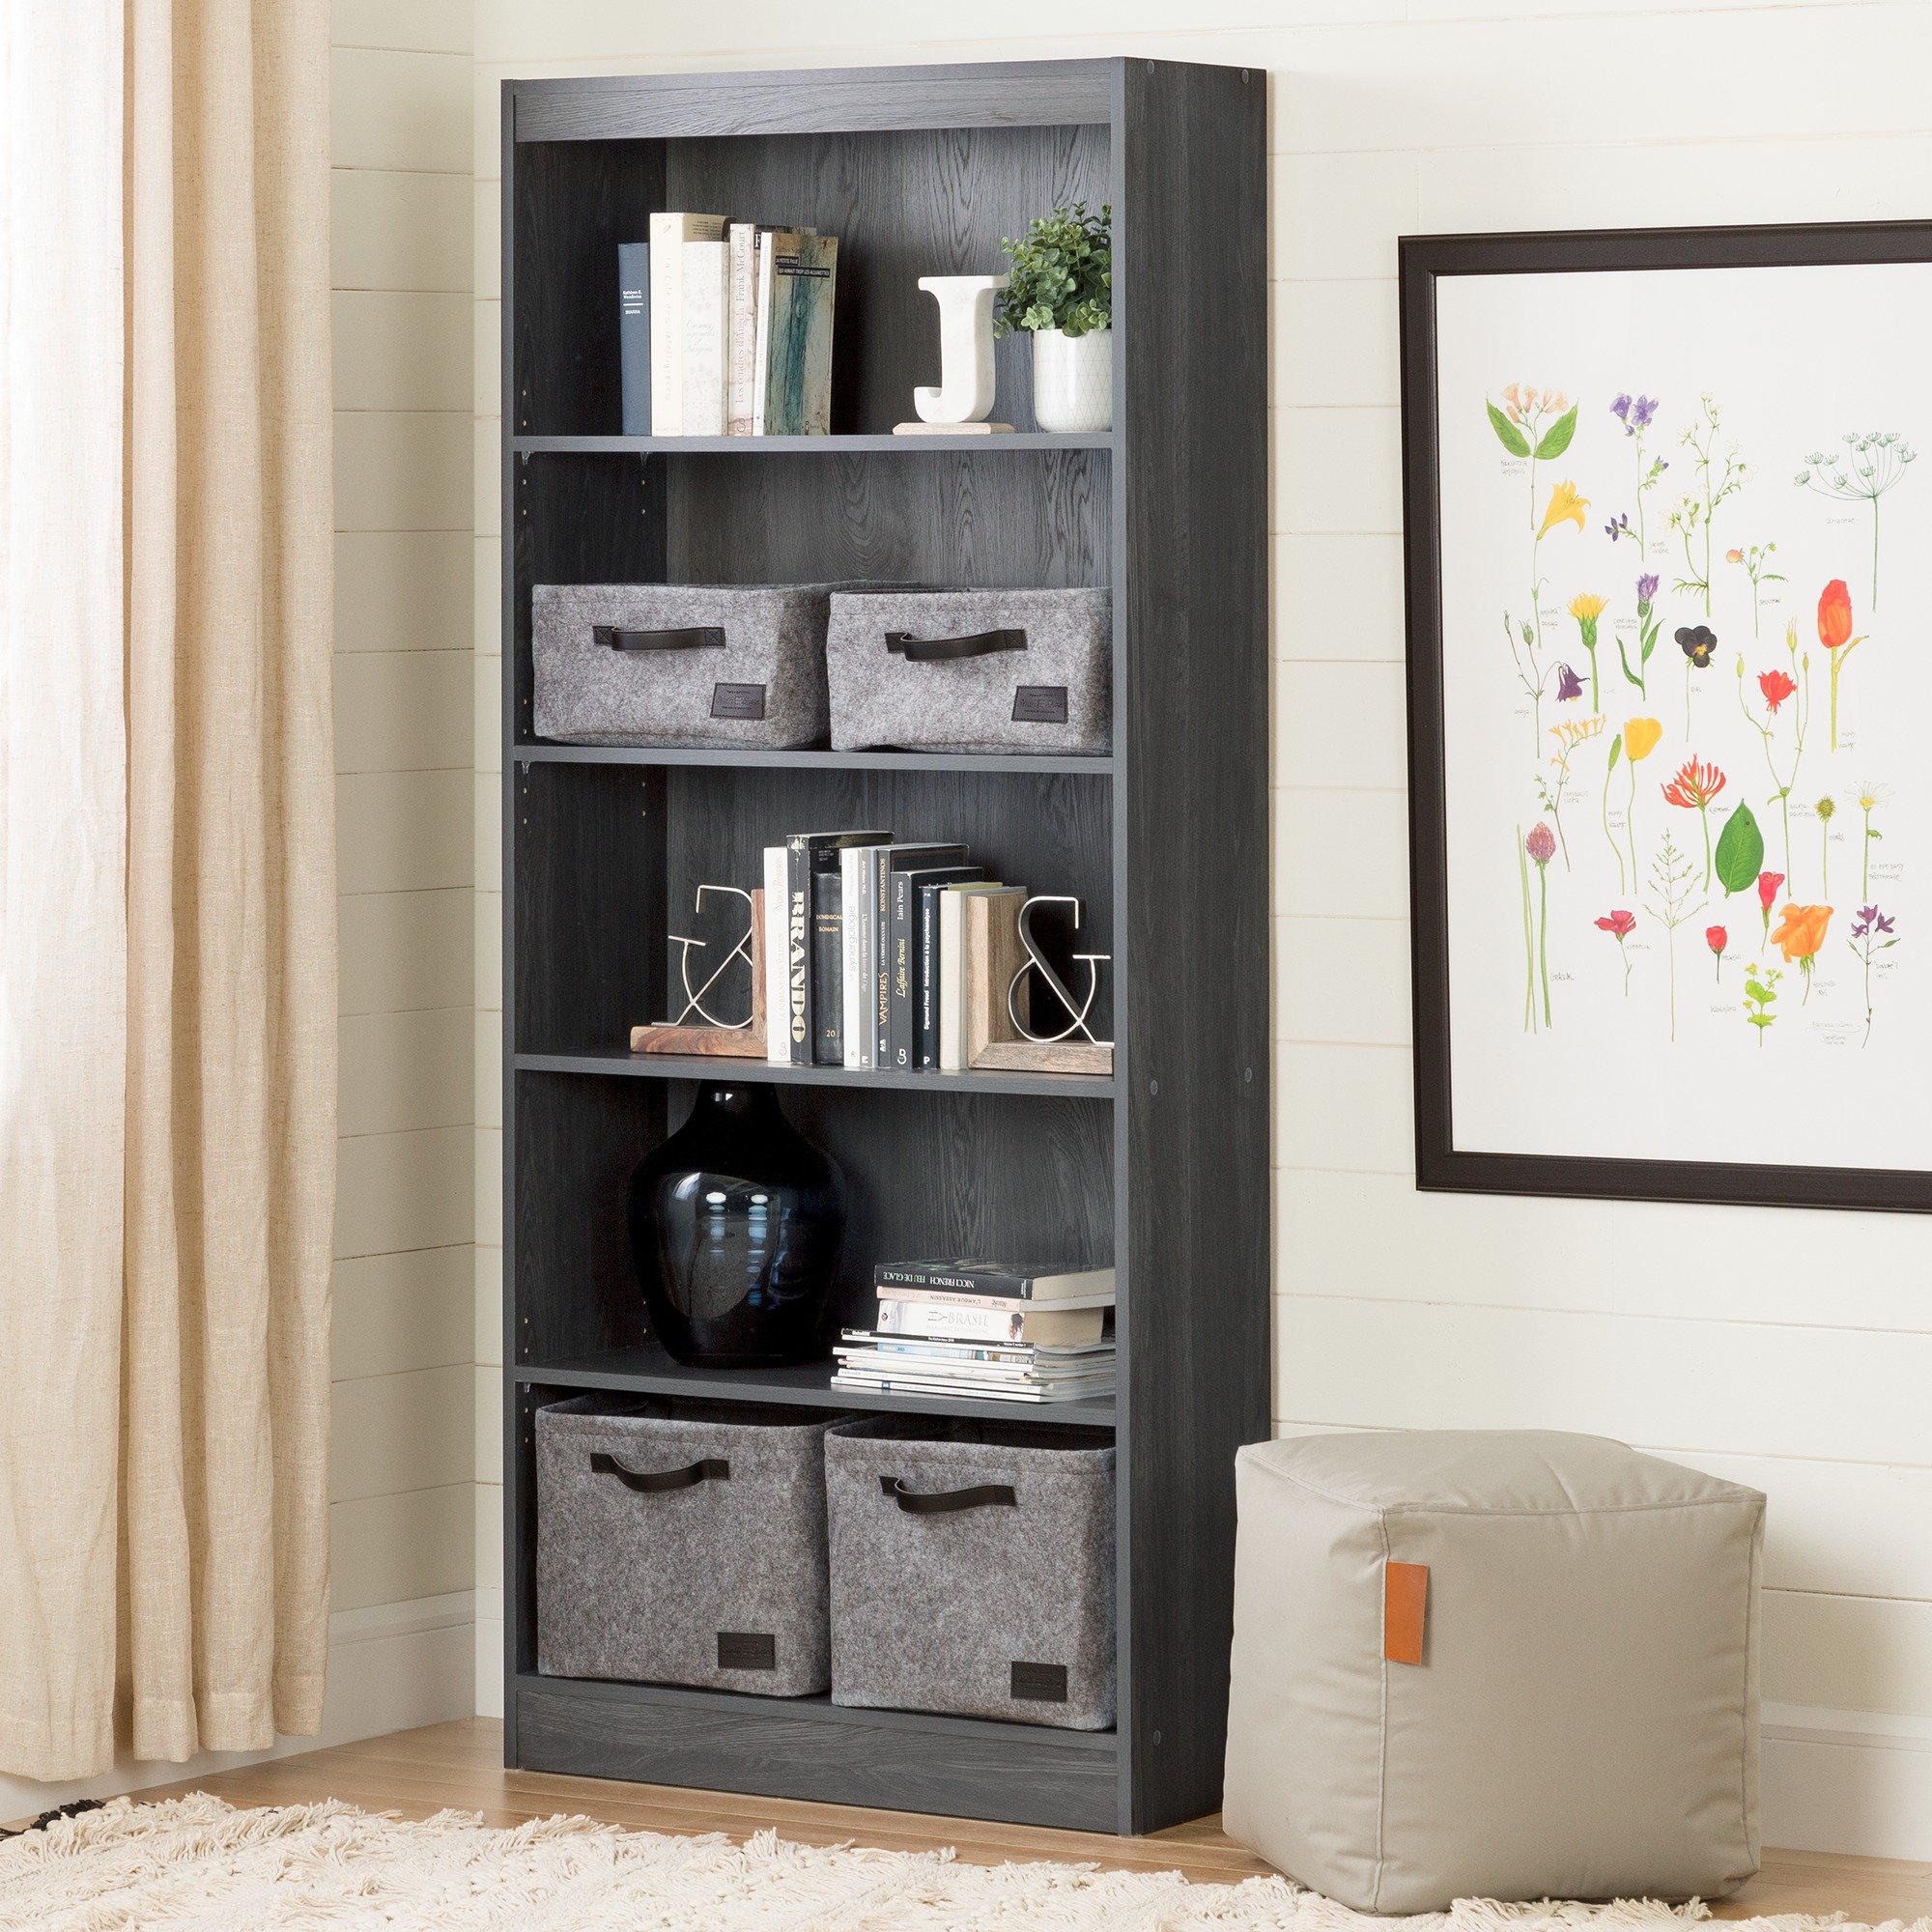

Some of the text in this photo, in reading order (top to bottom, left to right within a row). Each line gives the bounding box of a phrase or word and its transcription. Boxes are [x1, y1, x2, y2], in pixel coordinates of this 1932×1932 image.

[735, 232, 746, 273] McCourt
[736, 275, 745, 301] Frank
[848, 905, 858, 972] synergologie
[896, 938, 906, 966] Bernini
[790, 891, 807, 1043] BRANDO
[878, 972, 890, 1026] VAMPIRES
[826, 1030, 836, 1038] 20
[883, 1271, 975, 1289] NICCI FRENCH FEU DE GLACE
